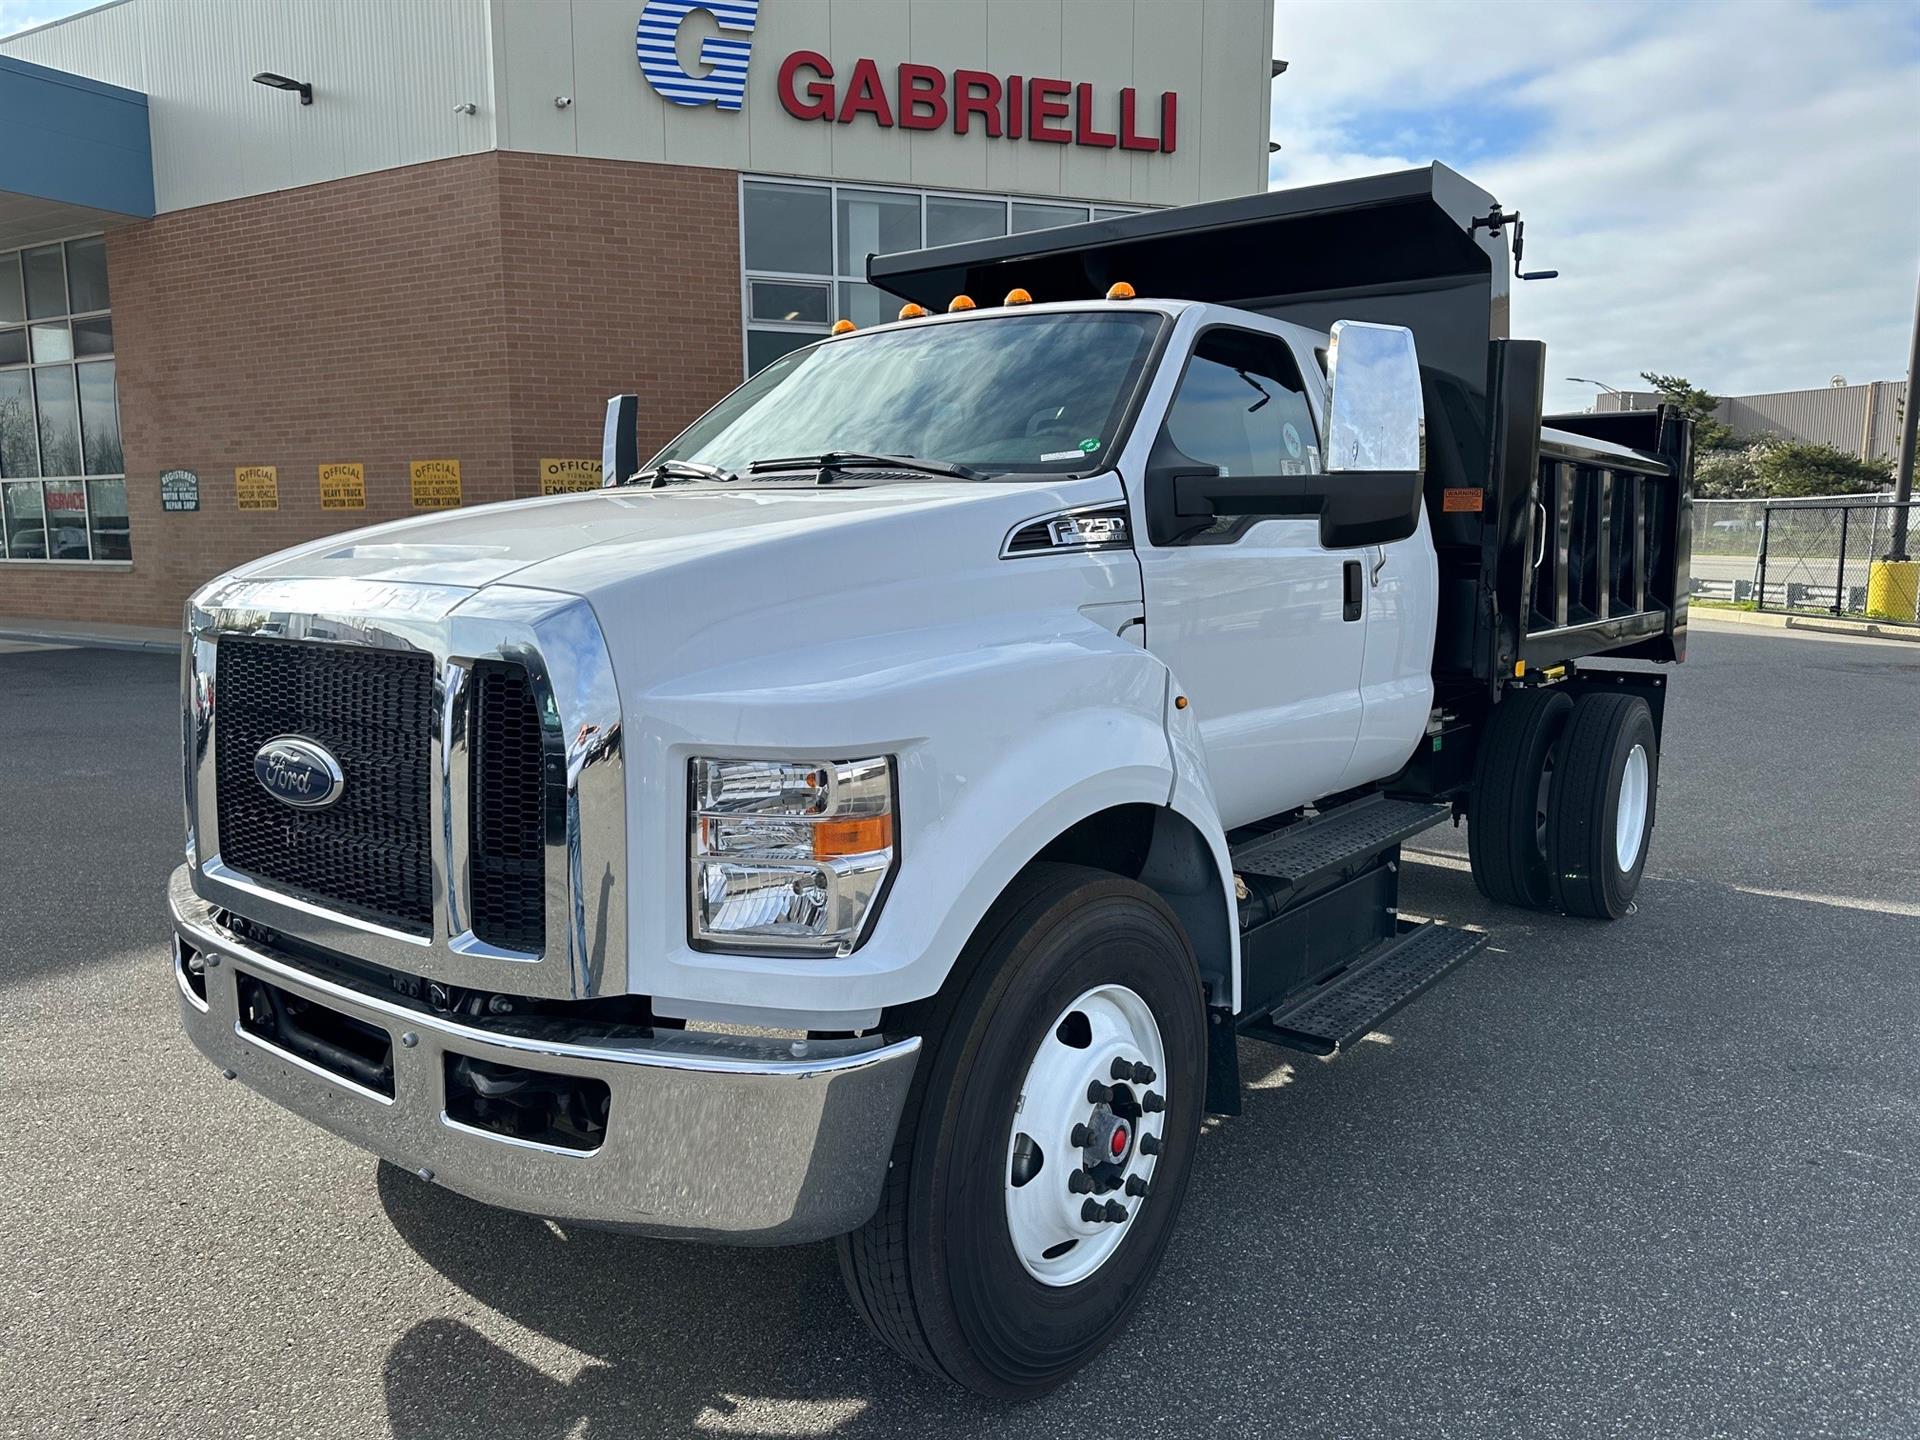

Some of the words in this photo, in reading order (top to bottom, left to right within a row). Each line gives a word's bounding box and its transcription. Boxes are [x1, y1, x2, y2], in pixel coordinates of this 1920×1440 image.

[636, 0, 759, 111] G
[777, 50, 1177, 153] GABRIELLI
[415, 462, 457, 478] OFFICIAL
[548, 461, 603, 474] OFFICIA
[162, 470, 197, 485] REGISTERED
[240, 469, 273, 482] OFFICIAL
[323, 466, 360, 480] OFFICIAL
[239, 490, 255, 499] MOTOR
[257, 490, 276, 498] VEHICLE
[323, 489, 341, 497] HEAVY
[343, 488, 361, 497] TRUCK
[413, 487, 431, 496] DIESEL
[432, 486, 459, 496] EMISSIONS
[545, 486, 600, 495] EMISSI
[163, 492, 178, 500] MOTOR
[179, 492, 198, 500] VEHICLE
[166, 501, 182, 509] REPAIR
[183, 501, 196, 510] SHOP
[239, 500, 261, 509] INSPECTION
[262, 500, 277, 508] STATION
[322, 499, 346, 508] INSPECTION
[347, 498, 365, 507] STATION
[413, 498, 440, 506] INSPECTION
[441, 497, 461, 506] STATION
[264, 750, 315, 794] Ford
